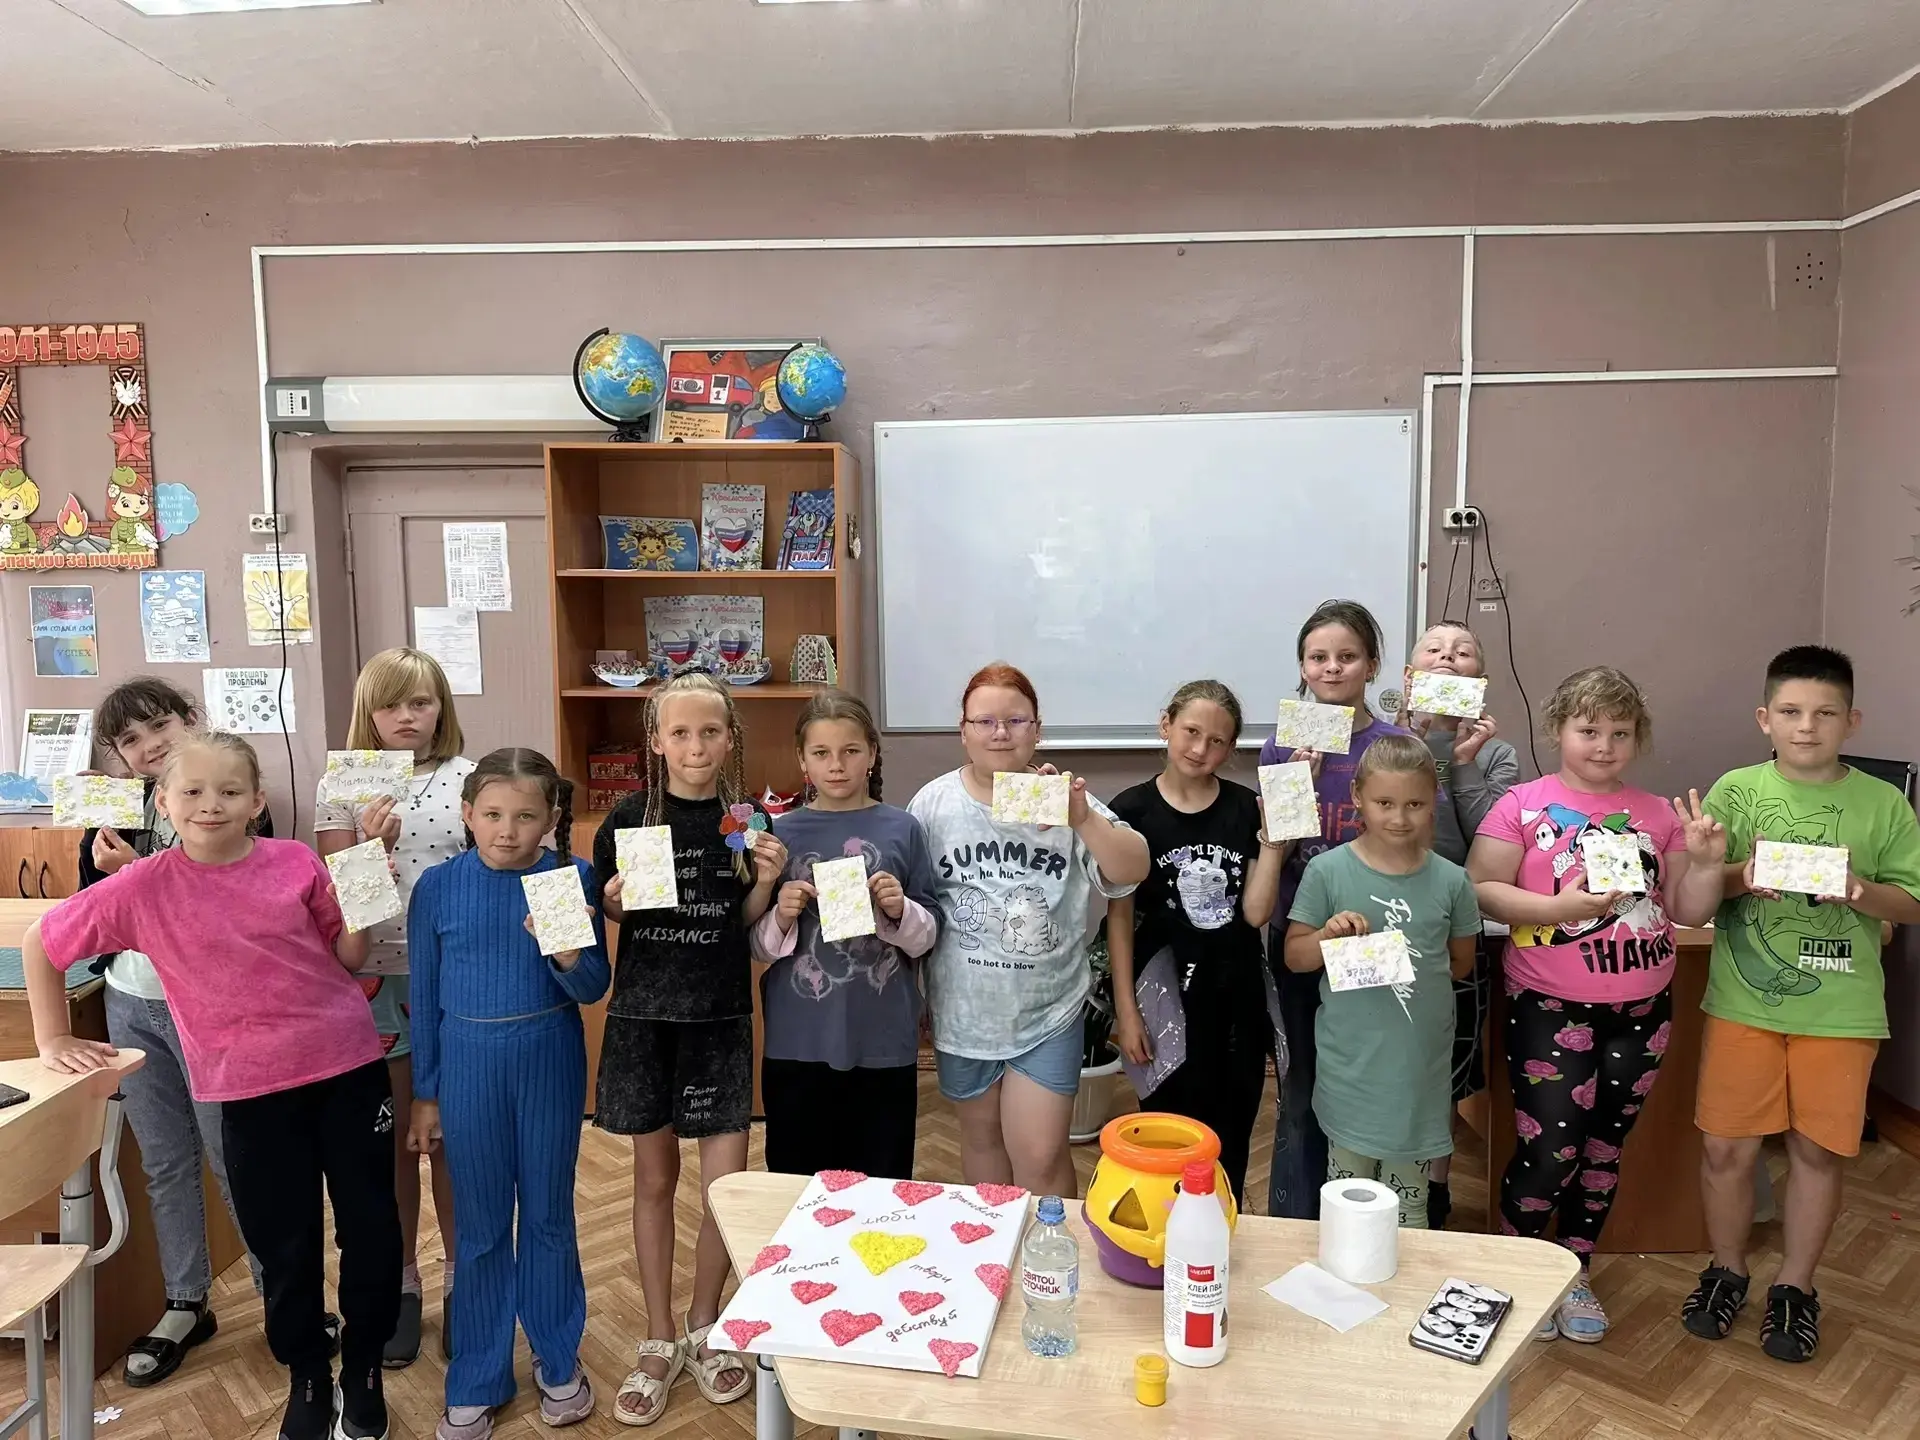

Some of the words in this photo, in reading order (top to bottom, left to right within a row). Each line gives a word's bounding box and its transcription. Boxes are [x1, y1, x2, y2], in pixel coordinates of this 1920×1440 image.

[0, 324, 140, 362] 941-1945
[66, 552, 87, 568] за
[225, 671, 239, 679] КАК
[240, 671, 268, 679] РЕШАТЬ
[939, 840, 1067, 881] SUMMER
[980, 866, 993, 879] hu
[684, 887, 696, 902] IN
[1800, 940, 1851, 958] DON'T
[968, 957, 981, 966] too
[983, 959, 999, 969] hot
[1001, 960, 1012, 969] to
[1013, 961, 1036, 971] blow
[1798, 957, 1856, 973] PANIC
[684, 1111, 702, 1121] THIS
[796, 1194, 828, 1211] сияй
[860, 1209, 917, 1225] люби
[771, 1256, 841, 1276] Мечтай
[909, 1263, 953, 1284] твори
[1187, 1283, 1208, 1293] КЛЕЙ
[1209, 1282, 1222, 1292] ПВА
[885, 1308, 958, 1343] действуй
